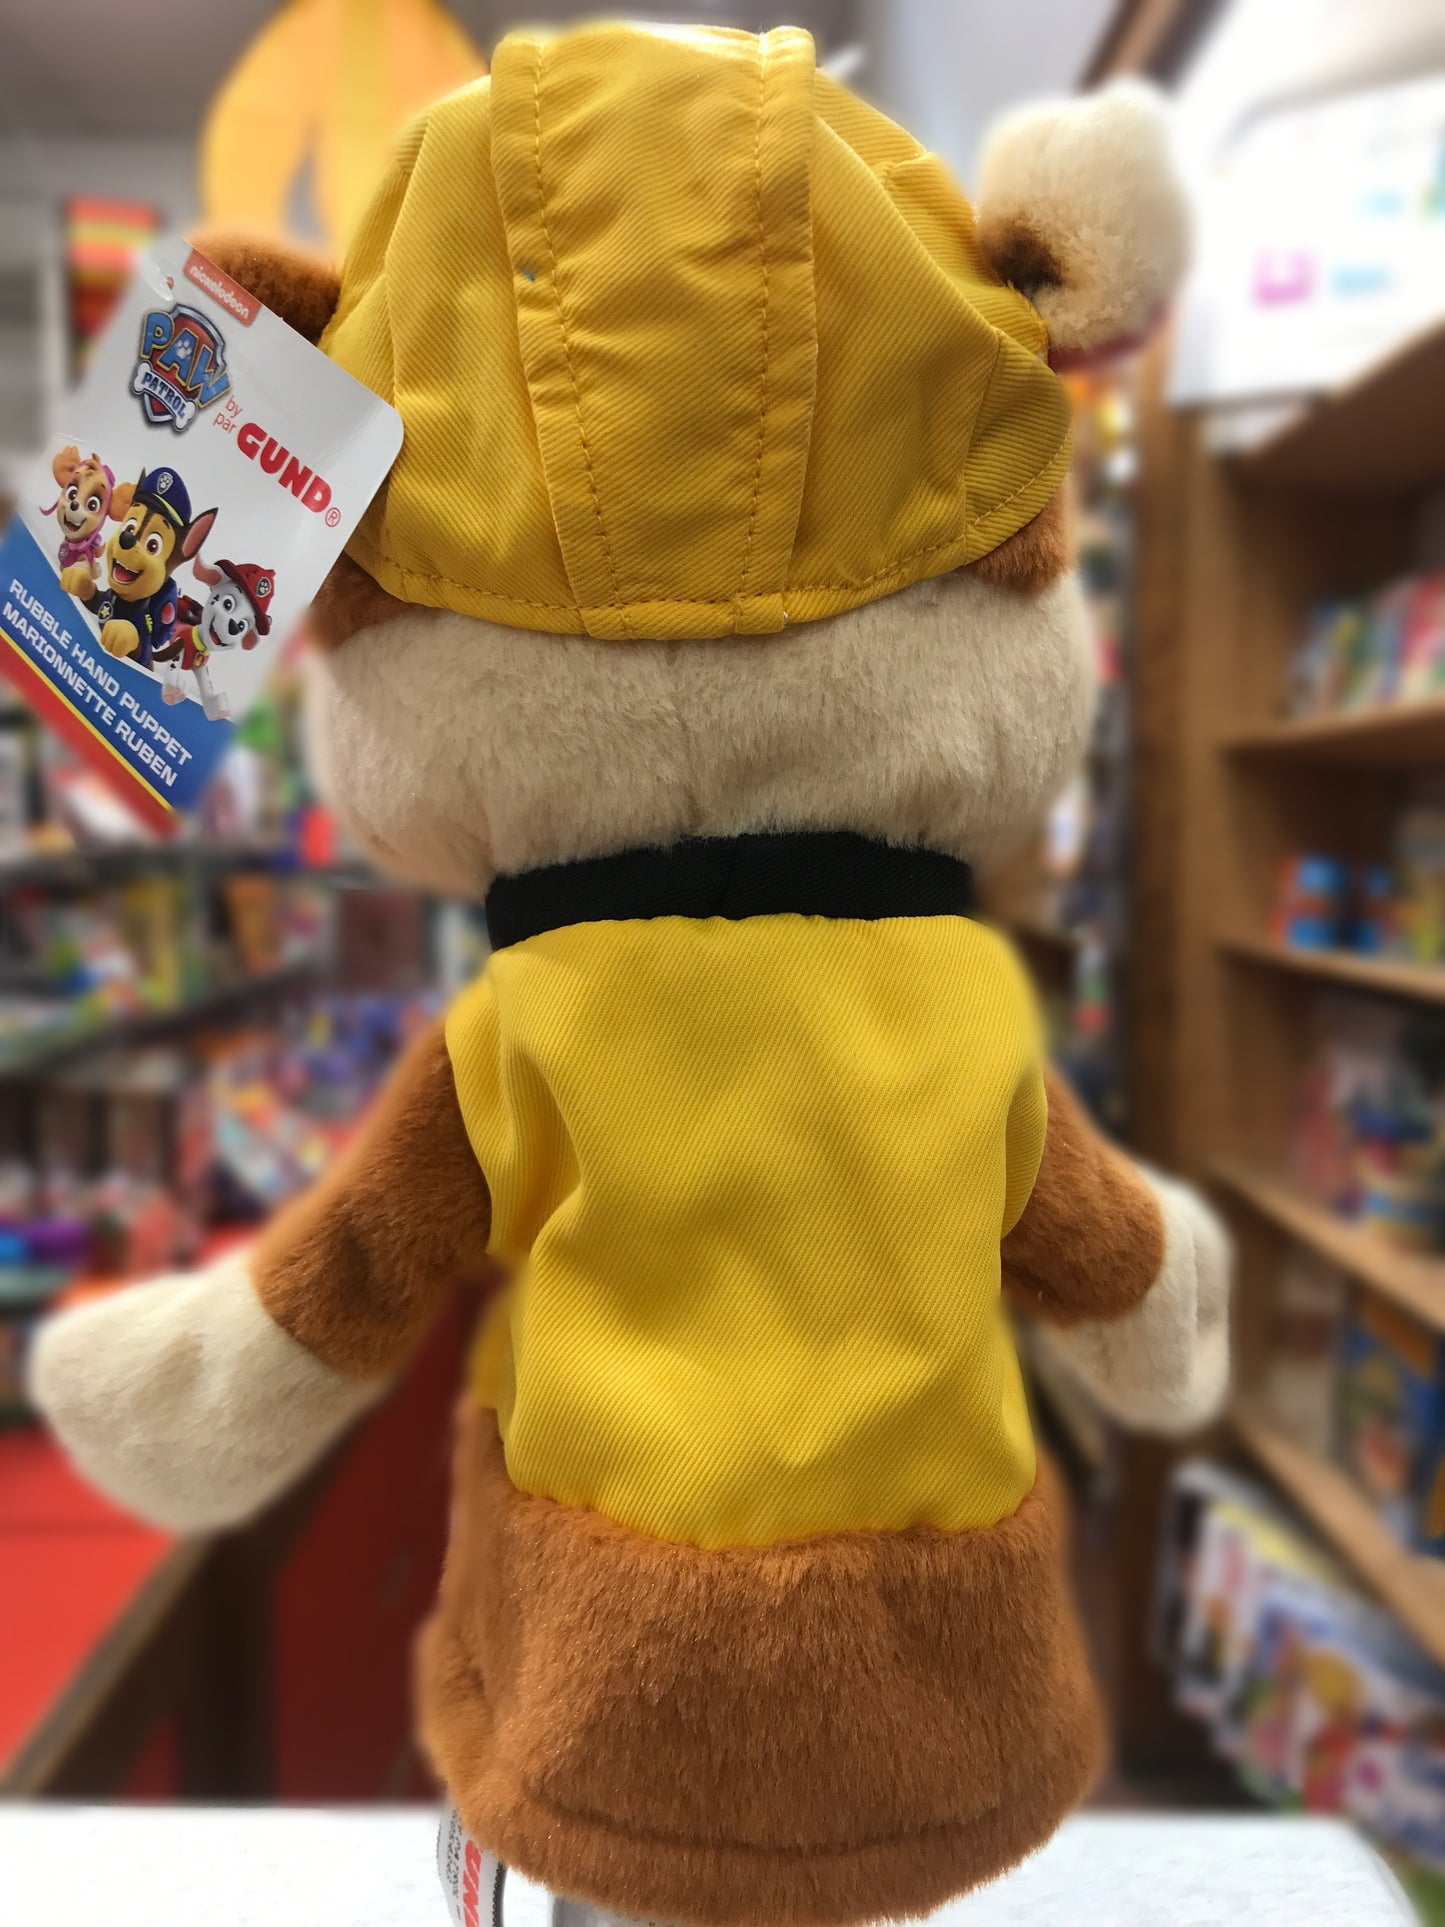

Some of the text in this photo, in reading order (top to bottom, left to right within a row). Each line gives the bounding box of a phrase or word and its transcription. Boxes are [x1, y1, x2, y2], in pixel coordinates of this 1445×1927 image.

[189, 265, 250, 320] nickelodeon
[139, 309, 233, 409] PAW
[141, 371, 187, 418] PATROL
[225, 394, 243, 418] by
[213, 412, 237, 434] par
[3, 601, 178, 787] MARIONNETTE RUBEN
[9, 579, 193, 766] RUBBLE HAND PUPPET
